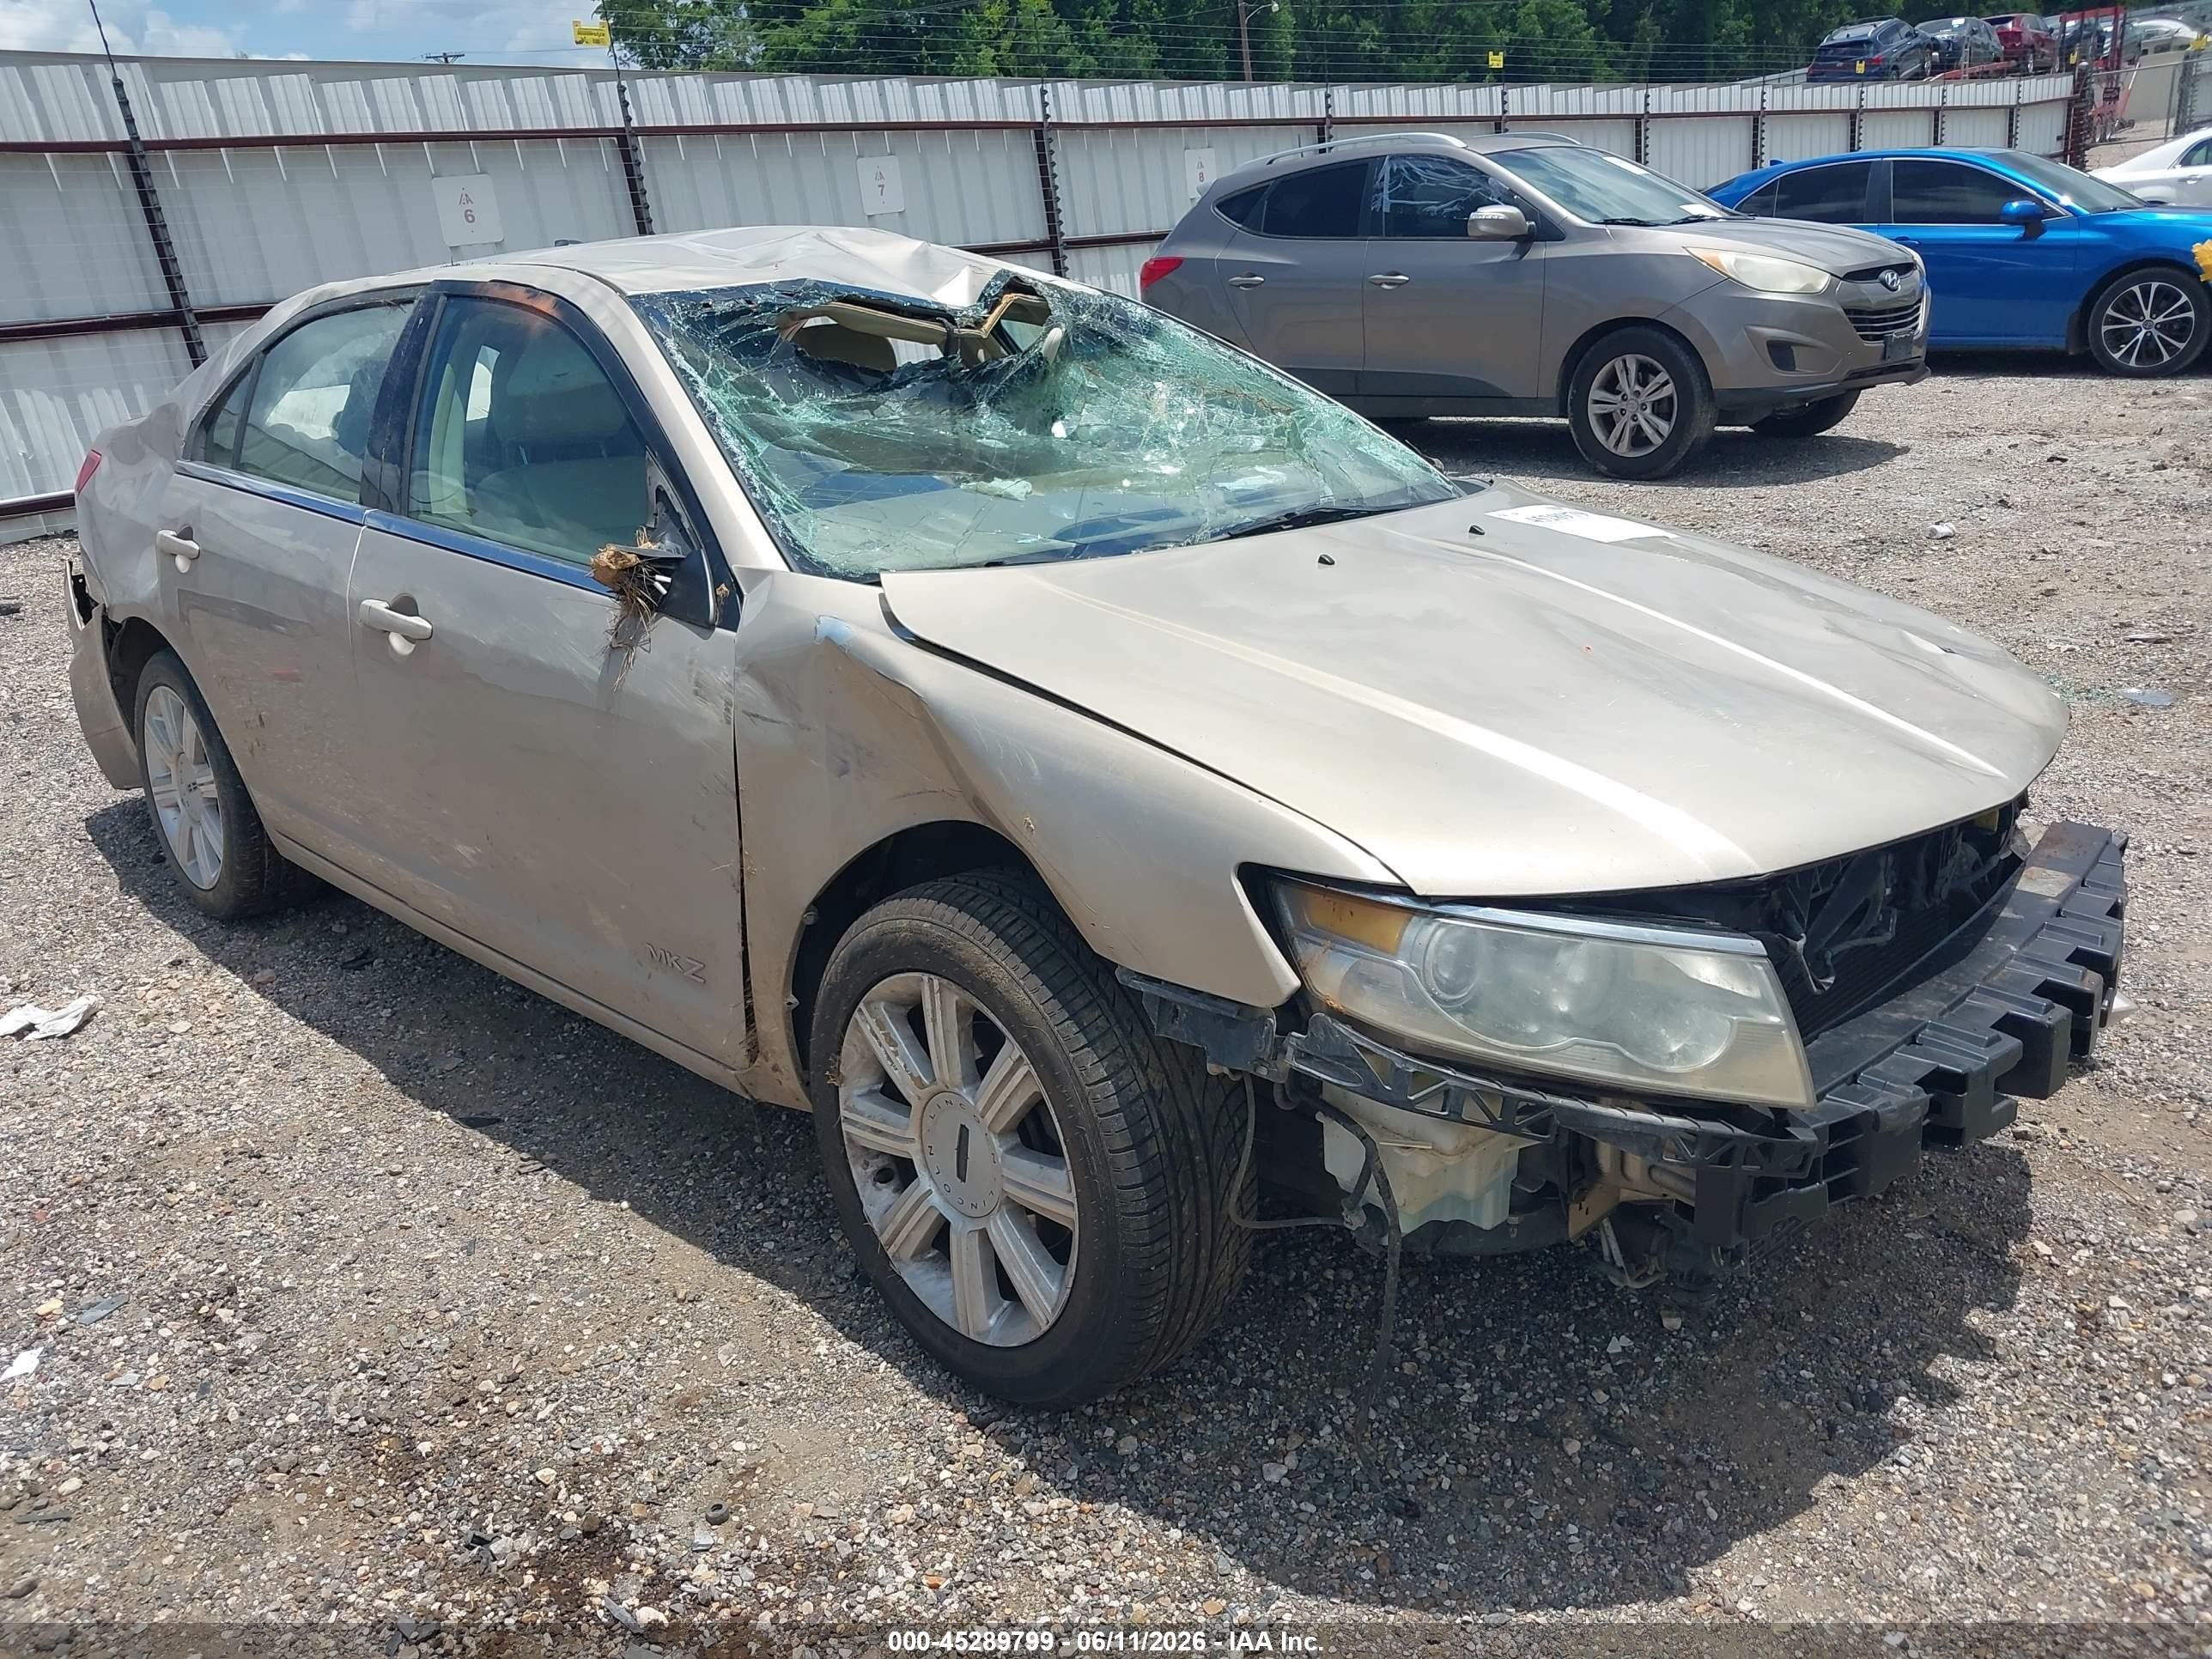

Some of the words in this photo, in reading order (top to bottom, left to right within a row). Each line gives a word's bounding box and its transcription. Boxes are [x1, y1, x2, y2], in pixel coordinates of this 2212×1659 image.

[878, 184, 885, 197] 7
[464, 209, 476, 223] 6
[646, 941, 707, 984] MKZ
